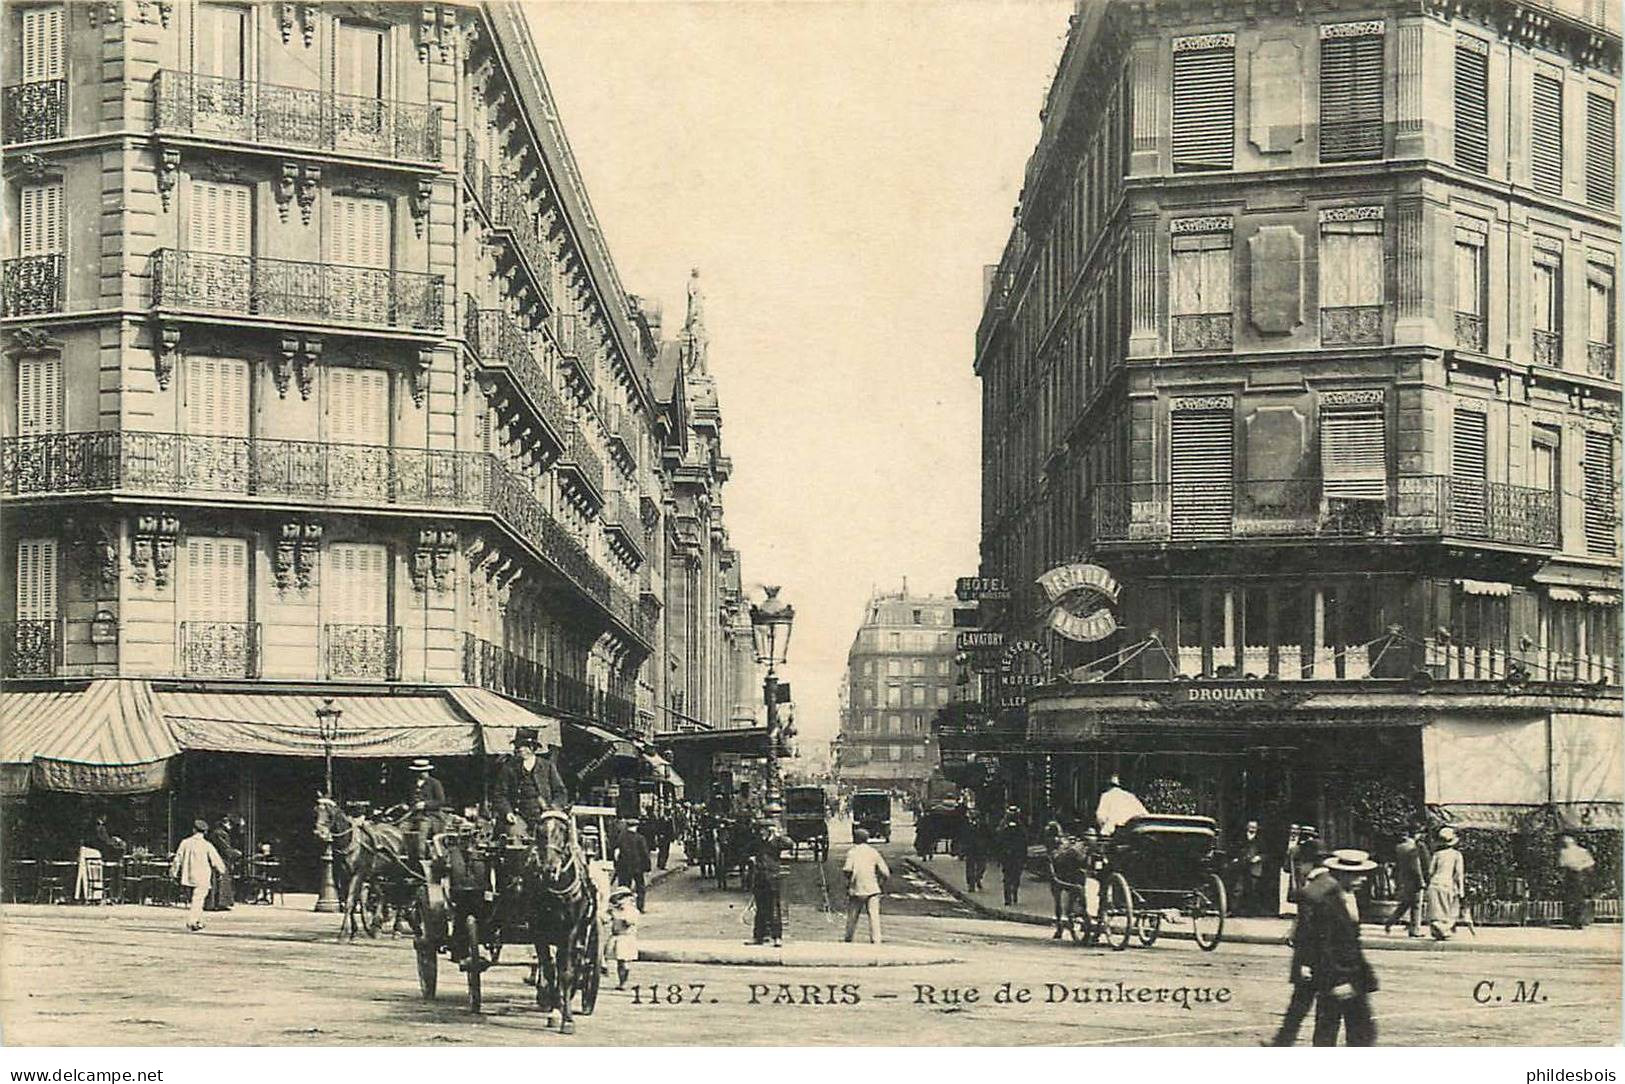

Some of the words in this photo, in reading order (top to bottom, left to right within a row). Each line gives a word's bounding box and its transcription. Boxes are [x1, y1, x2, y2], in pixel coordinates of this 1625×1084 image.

[962, 578, 1009, 591] HOTEL
[962, 632, 1003, 646] LAVATORY
[1188, 688, 1266, 701] DROUANT
